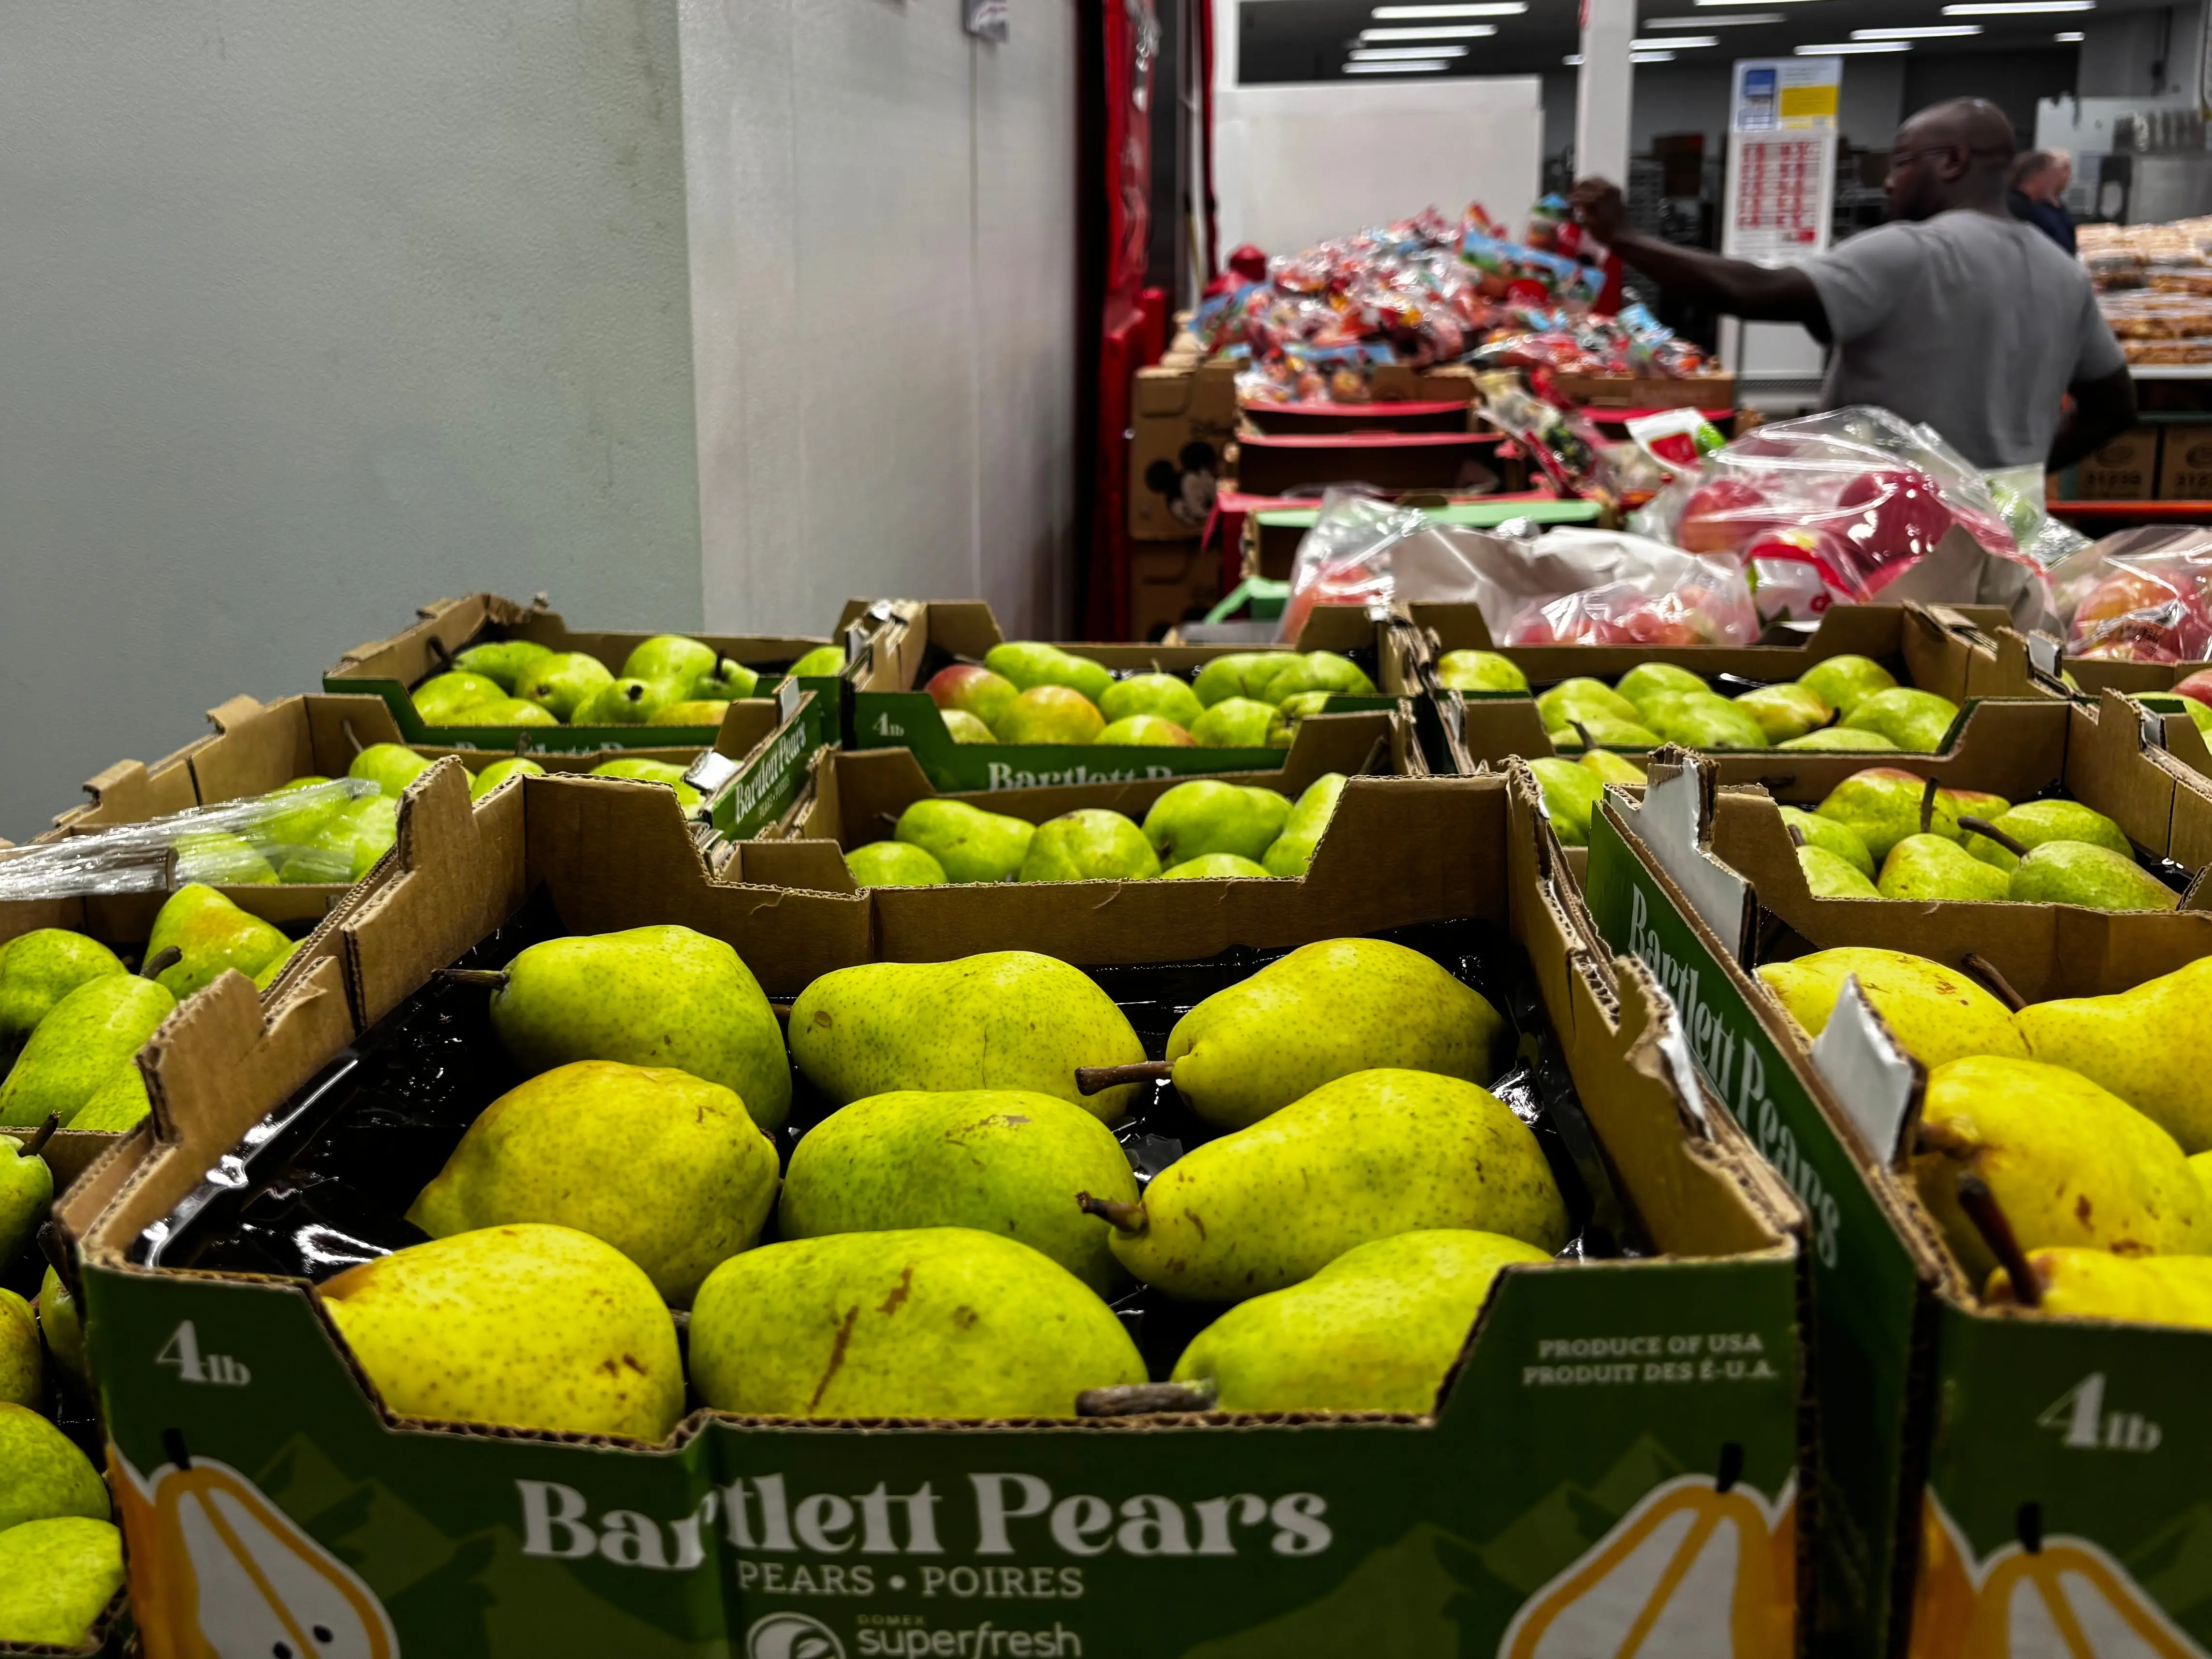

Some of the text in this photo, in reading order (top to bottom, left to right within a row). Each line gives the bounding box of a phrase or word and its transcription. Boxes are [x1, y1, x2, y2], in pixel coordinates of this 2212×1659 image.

[735, 721, 806, 825] Bartlett Pears
[1628, 882, 1840, 1269] Bartlett Pears
[156, 1319, 251, 1385] 4lb
[1539, 1333, 1763, 1358] PRODUCE OF USA
[1523, 1363, 1638, 1385] PRODUIT
[1644, 1362, 1693, 1382] DES
[515, 1472, 1334, 1570] Bartlett Pears
[737, 1560, 1085, 1598] PEARS POIRES
[858, 1614, 925, 1626] DOMEX
[858, 1620, 1081, 1659] superfresh
